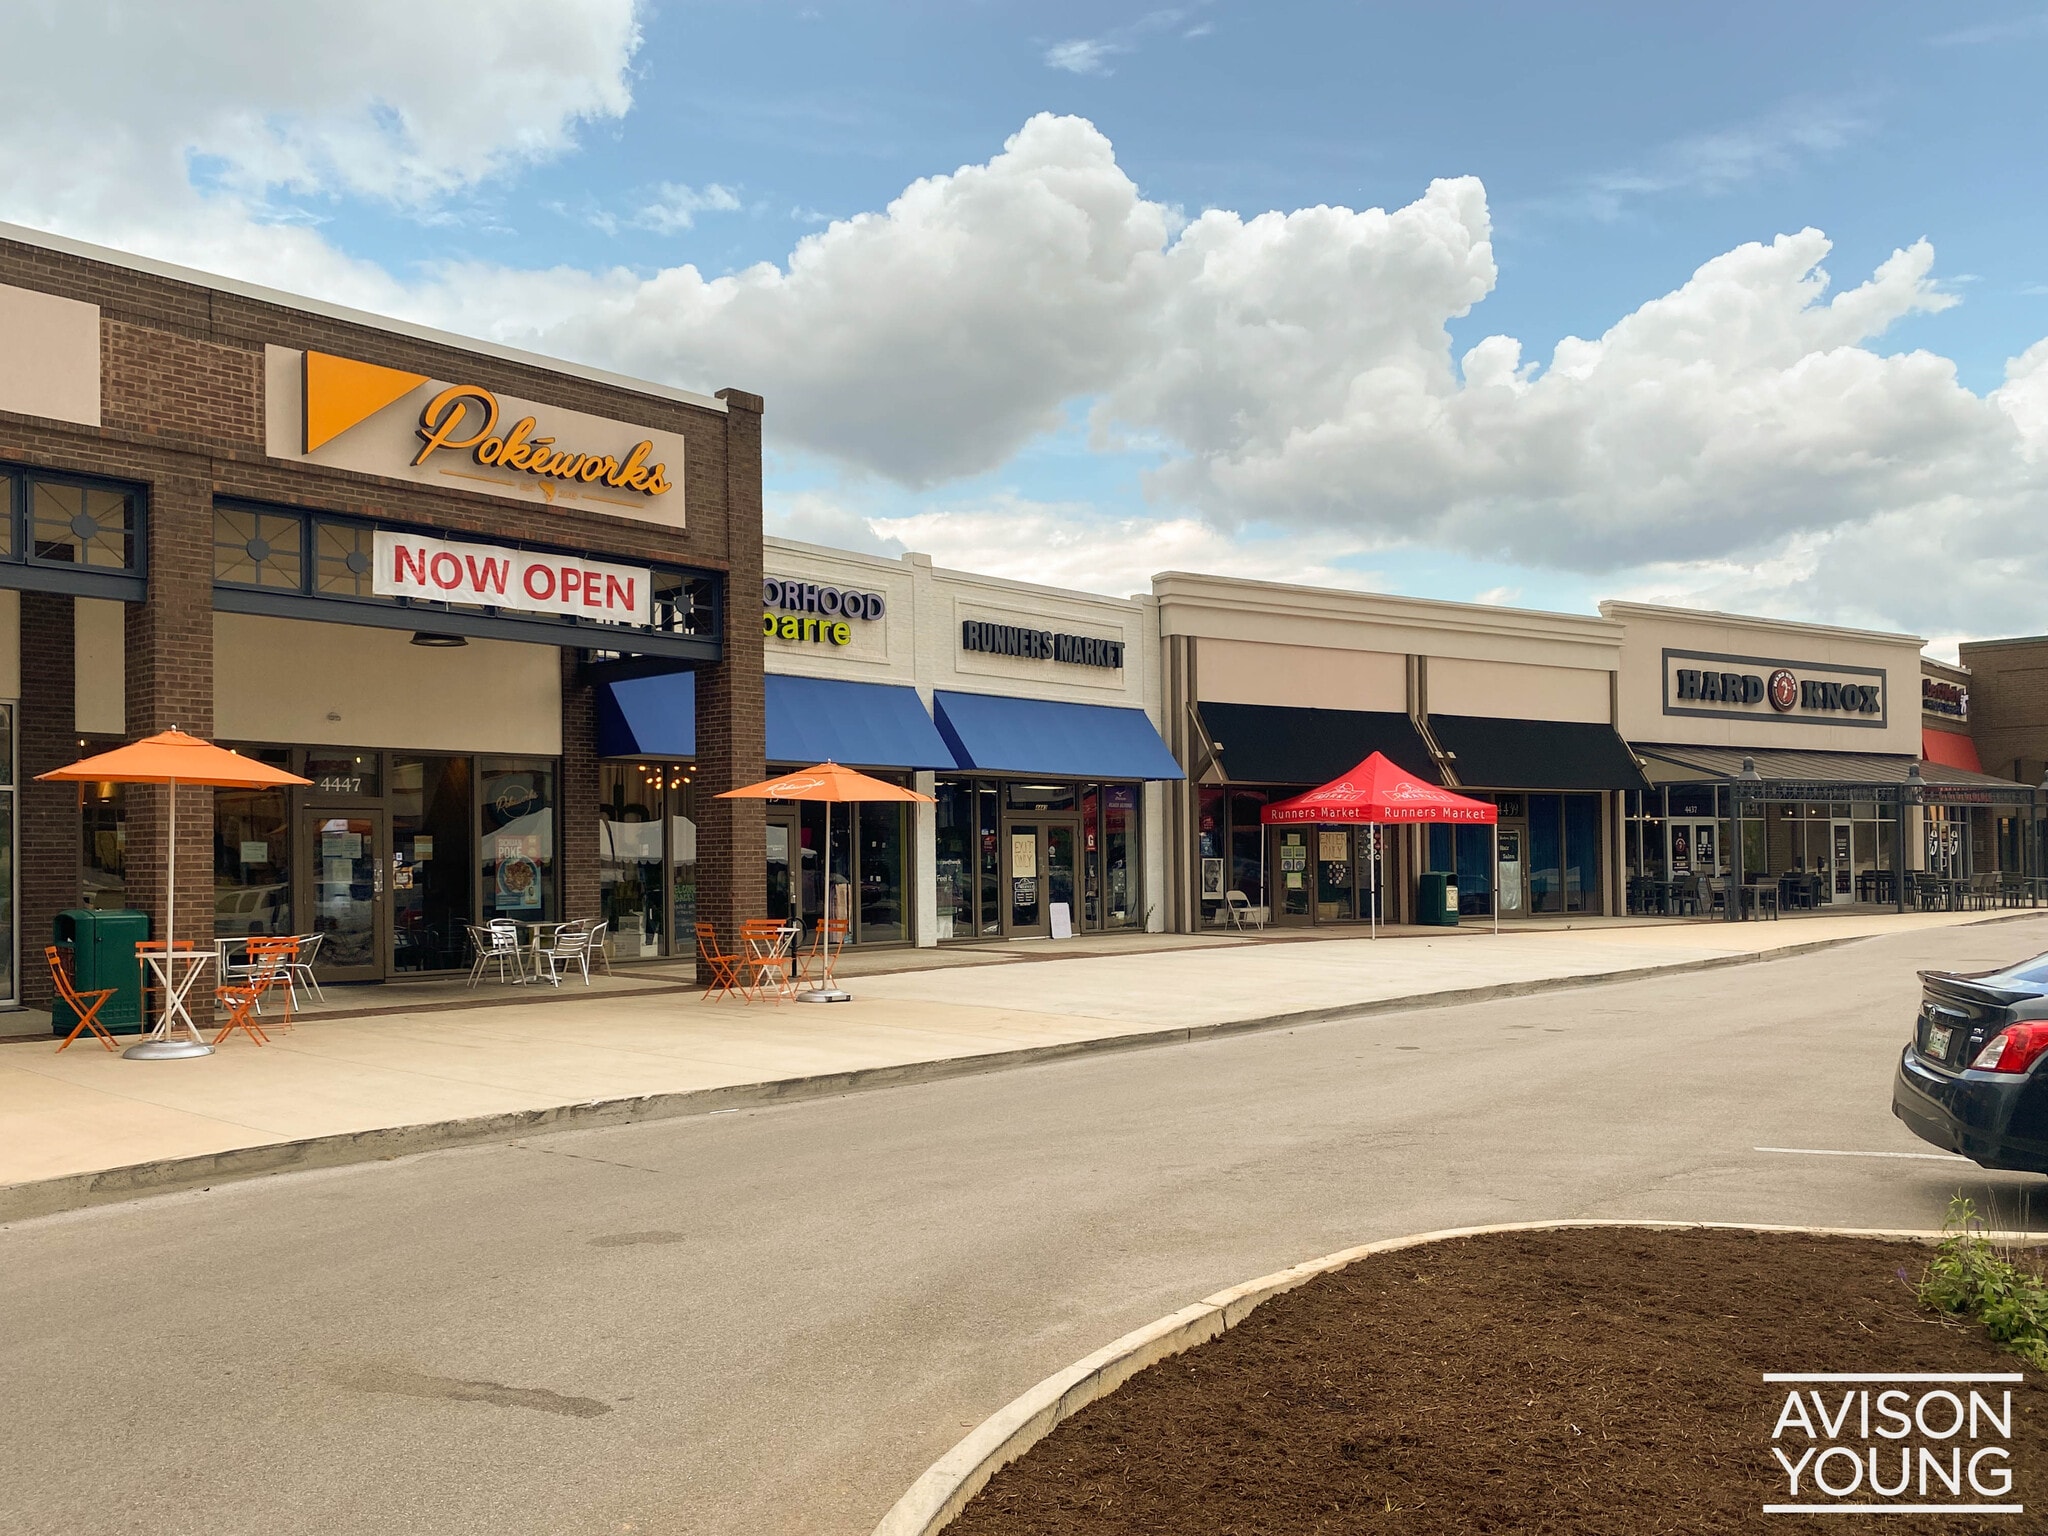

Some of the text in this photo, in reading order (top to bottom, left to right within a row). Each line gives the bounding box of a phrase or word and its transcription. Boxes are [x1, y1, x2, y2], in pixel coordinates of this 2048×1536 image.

[393, 544, 635, 612] NOW OPEN
[763, 577, 885, 621] ORHOOD
[963, 620, 1126, 669] RUNNERS MARKET
[1677, 669, 1881, 713] HARD KNOX
[320, 777, 361, 792] 4447
[1271, 807, 1360, 819] Runners Market
[1384, 807, 1486, 820] Runners Market
[1684, 805, 1698, 814] 4437
[1320, 832, 1345, 845] ENTER
[1014, 840, 1034, 854] EXIT
[1322, 845, 1343, 859] ONLY
[1014, 854, 1033, 868] ONLY
